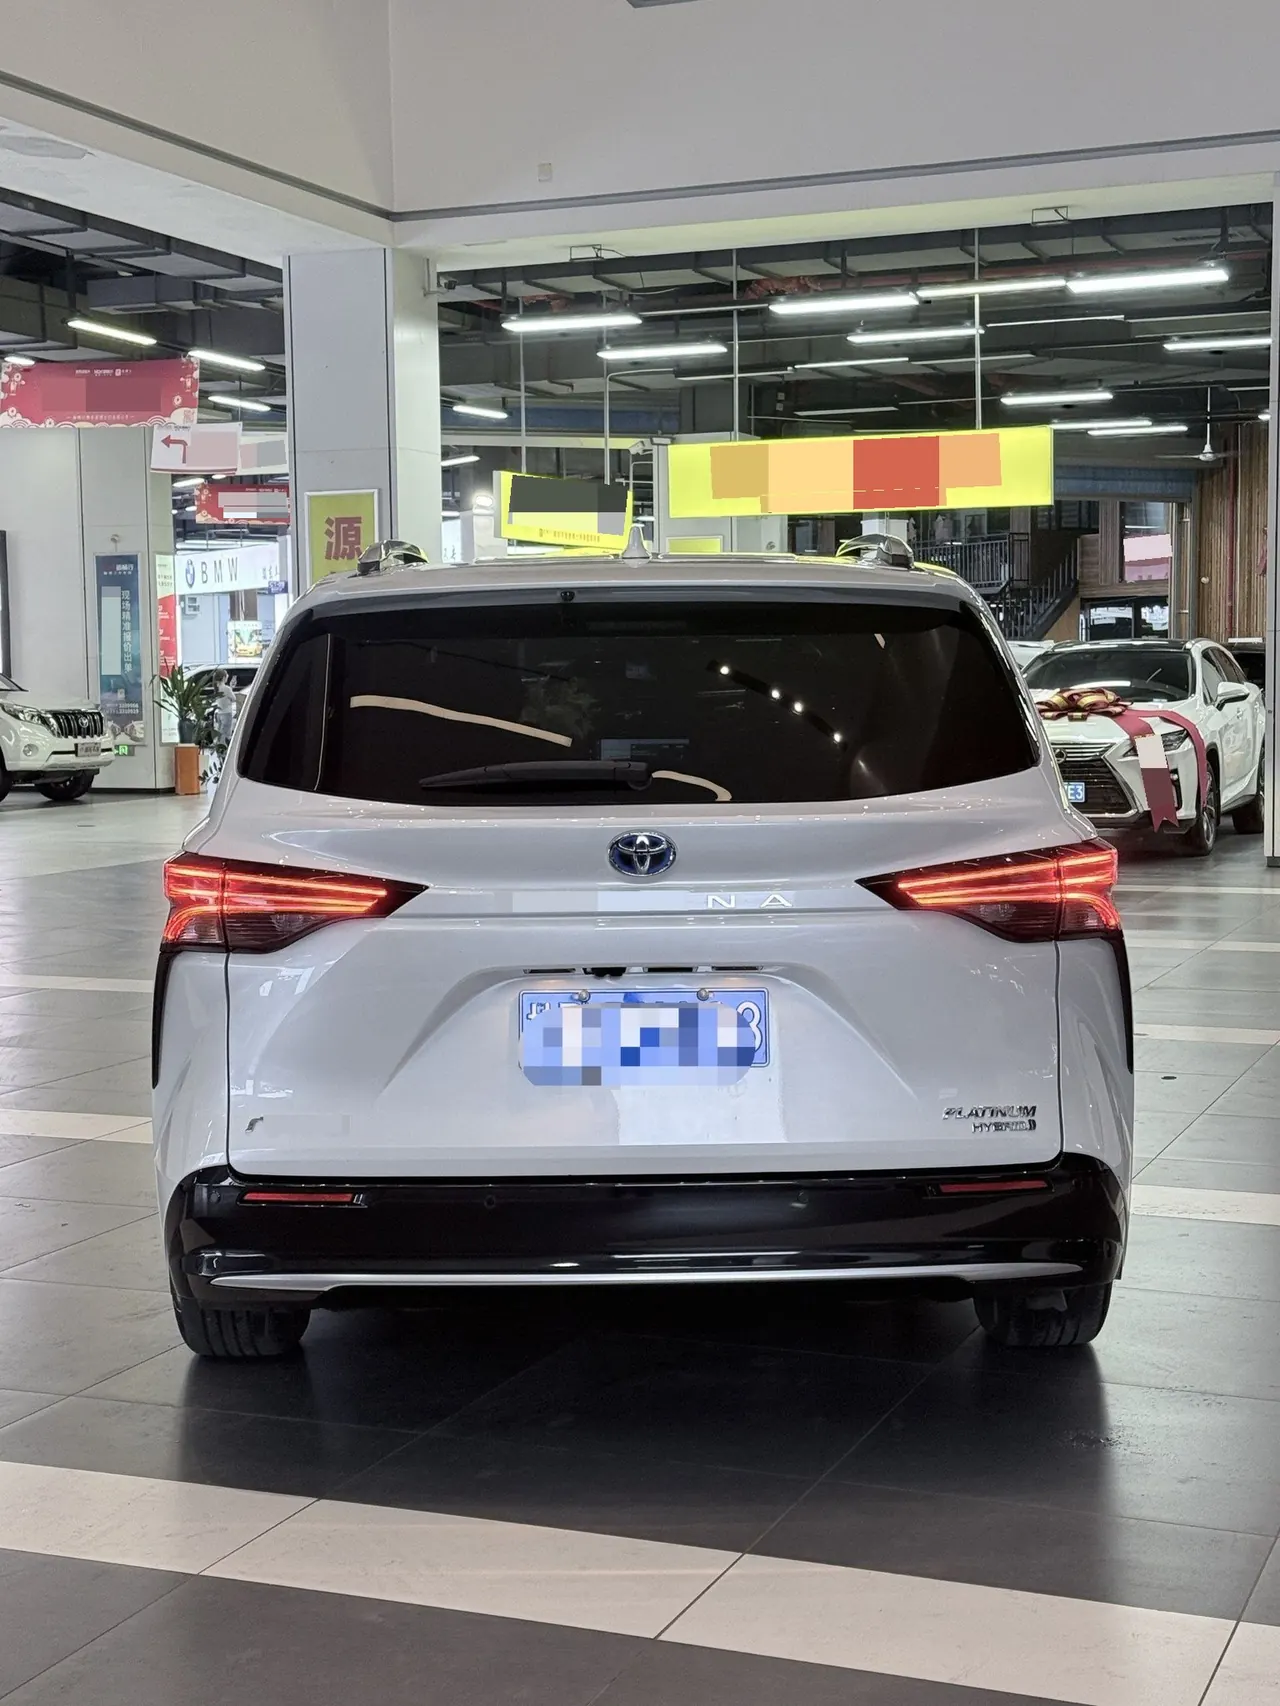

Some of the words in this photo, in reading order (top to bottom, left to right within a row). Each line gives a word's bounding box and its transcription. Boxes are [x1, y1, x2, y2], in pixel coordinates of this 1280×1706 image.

[324, 516, 362, 560] 源
[200, 556, 238, 584] BMW
[121, 590, 132, 673] 现场精准报价出单
[943, 1105, 1037, 1119] PLATINUM
[972, 1120, 1029, 1133] HYBRID
